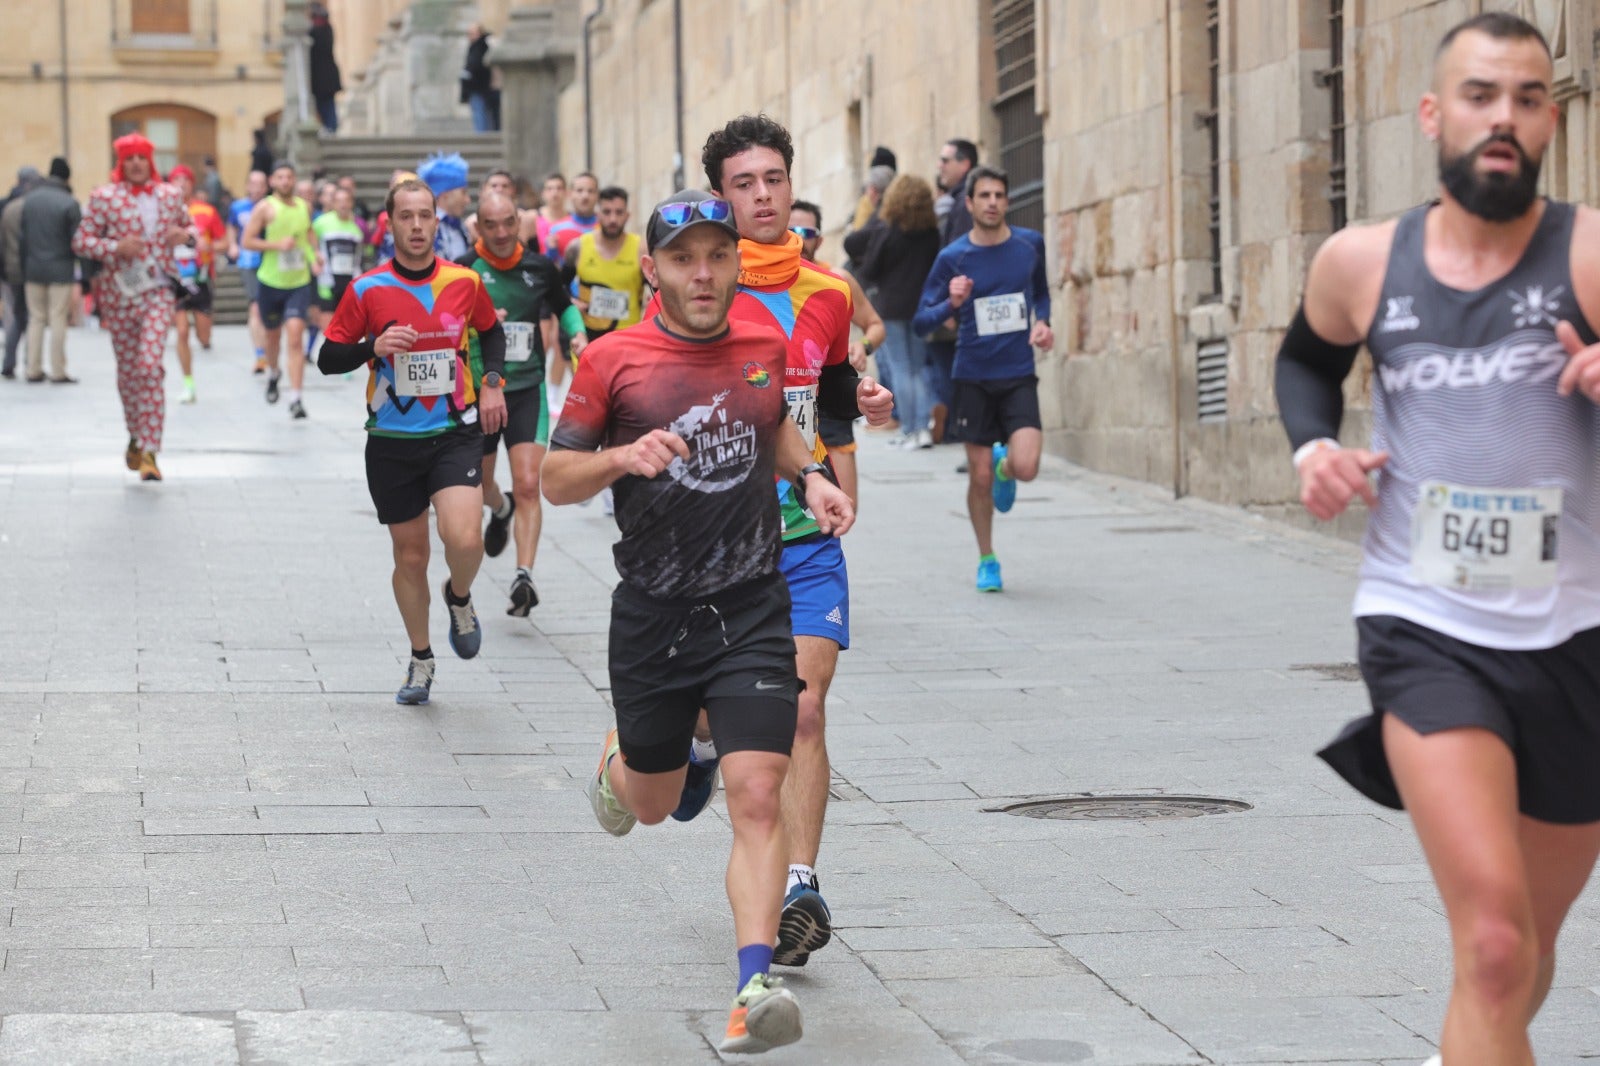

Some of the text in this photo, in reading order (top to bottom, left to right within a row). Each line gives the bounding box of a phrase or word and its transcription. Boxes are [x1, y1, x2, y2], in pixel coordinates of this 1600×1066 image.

[987, 305, 1011, 321] 250
[411, 352, 450, 362] SETEL
[408, 363, 438, 381] 634
[1379, 343, 1570, 394] WOLVES
[717, 408, 727, 424] V
[694, 425, 730, 450] TRAIL
[698, 439, 749, 470] LA RAYA
[1443, 513, 1510, 555] 649
[825, 615, 843, 626] adidas
